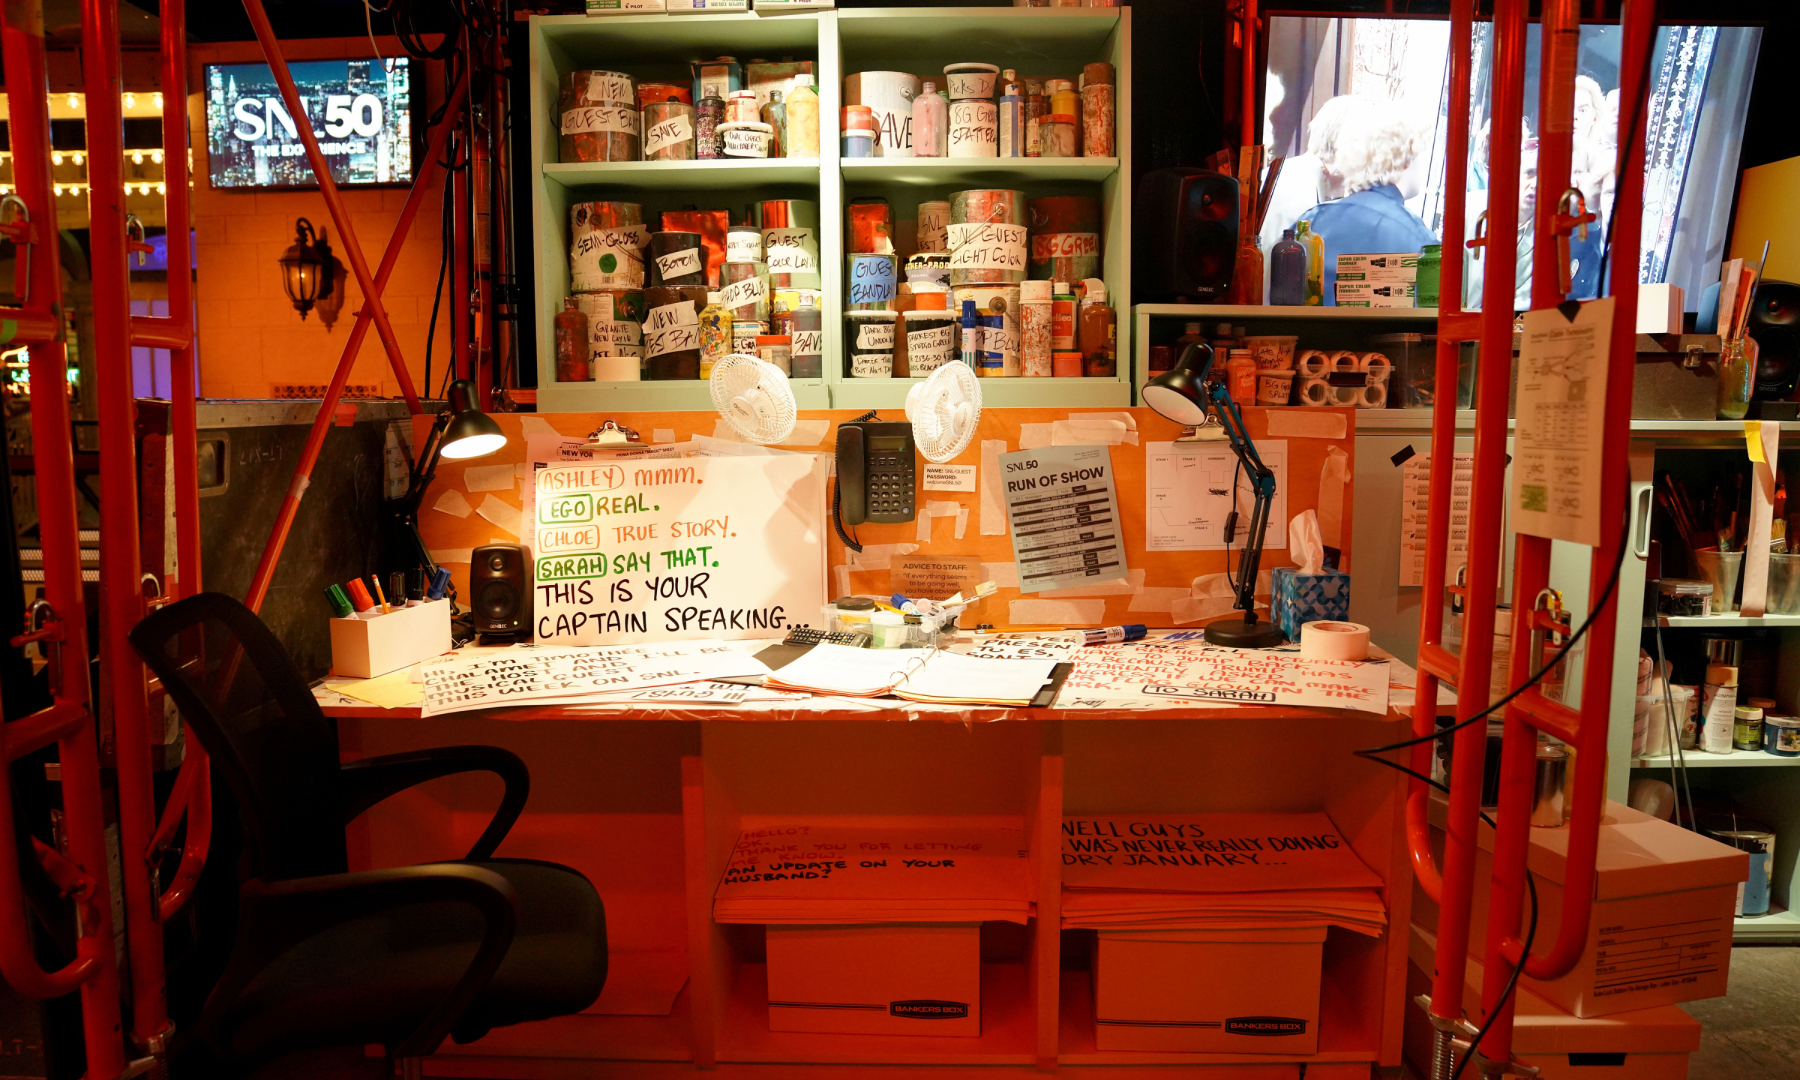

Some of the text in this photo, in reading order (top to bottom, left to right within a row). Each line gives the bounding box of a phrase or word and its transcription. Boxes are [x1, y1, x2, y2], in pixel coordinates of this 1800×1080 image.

[602, 80, 627, 99] NEW
[564, 110, 613, 129] GUEST
[651, 123, 681, 144] SAVE
[252, 145, 280, 157] THE
[923, 215, 943, 236] SNL
[981, 225, 1027, 243] GUEST
[765, 232, 807, 248] GUEST
[653, 309, 679, 330] NEW
[1006, 460, 1039, 473] SNL50
[543, 468, 615, 490] ASHLEY
[1008, 466, 1104, 493] RUN OF SHOW
[551, 493, 660, 519] EGO REAL.
[544, 516, 737, 548] CHLOE TRUE STORY.
[541, 546, 720, 579] SARAH SAY THAT.
[537, 572, 710, 607] THIS IS YOUR
[538, 605, 809, 639] CAPTAIN SPEAKING...
[424, 661, 553, 686] CHALAMET
[573, 656, 624, 665] AND
[700, 646, 733, 654] BE
[1076, 649, 1126, 657] HAVE
[1177, 655, 1233, 665] JUMP
[1248, 660, 1309, 670] BACK
[1102, 656, 1188, 668] BECAUSE
[1208, 664, 1285, 674] TRUMP
[1301, 670, 1353, 679] HAS
[1266, 655, 1366, 668] ACTUALLY
[426, 661, 628, 692] THE HOST AND
[428, 665, 637, 700] MUSICAL GUEST
[1210, 670, 1284, 680] ASKED
[427, 691, 488, 706] THIS
[499, 681, 582, 695] WEEK
[592, 676, 629, 686] ON
[1112, 676, 1172, 686] FLAG
[1186, 681, 1261, 691] GLOW
[1319, 689, 1371, 701] THE
[1148, 685, 1267, 701] TO SARAH
[1306, 682, 1379, 695] MAKE
[744, 826, 810, 840] HELLO?
[1129, 822, 1205, 838] GUYS
[735, 843, 984, 858] THANK YOU FOR LETTING
[1069, 834, 1340, 854] WAS NEVER REALLY DOING
[727, 859, 956, 876] AN UPDATE ON YOUR
[731, 852, 844, 867] ME KNOW.
[1061, 852, 1288, 867] DRY JANUARY...
[724, 868, 833, 885] HUSBAND?
[895, 1005, 963, 1013] BANKERS BOX
[1229, 1021, 1302, 1030] BANKERS BOX
